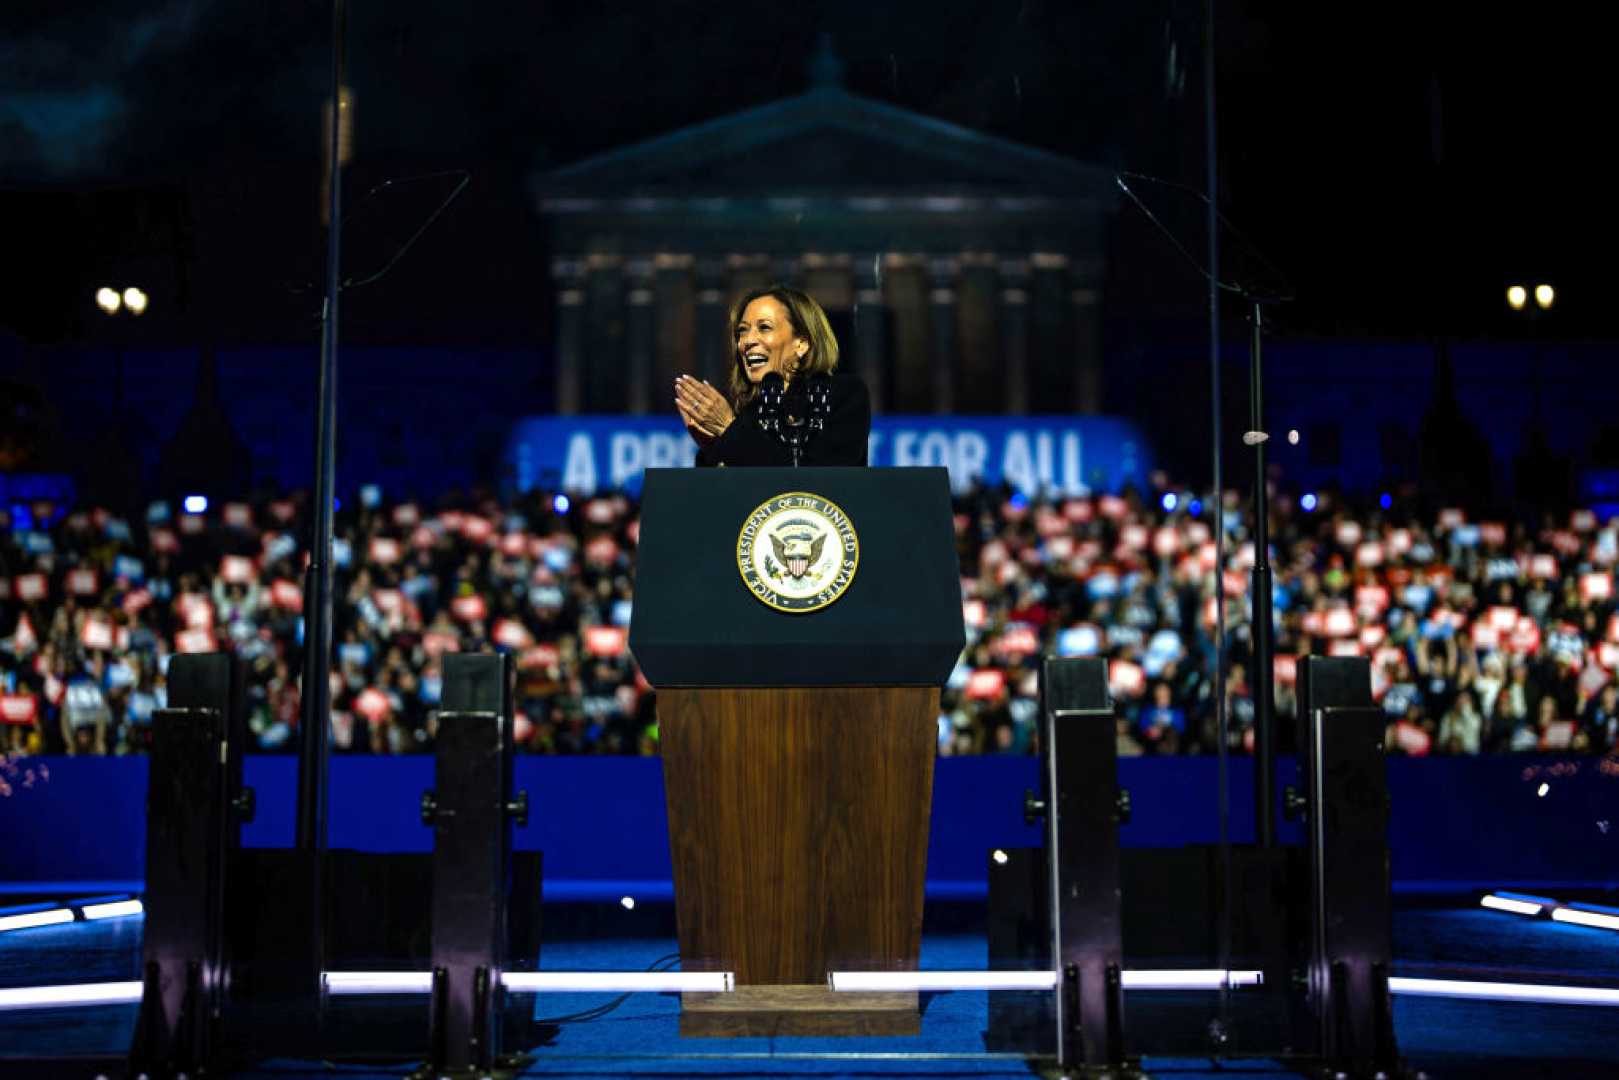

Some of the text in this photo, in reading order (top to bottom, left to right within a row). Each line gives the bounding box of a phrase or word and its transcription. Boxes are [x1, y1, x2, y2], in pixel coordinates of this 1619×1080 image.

[562, 432, 597, 496] A
[1004, 431, 1091, 499] ALL
[740, 497, 855, 605] VICE PRESIDENT OF THE UNITED STATES
